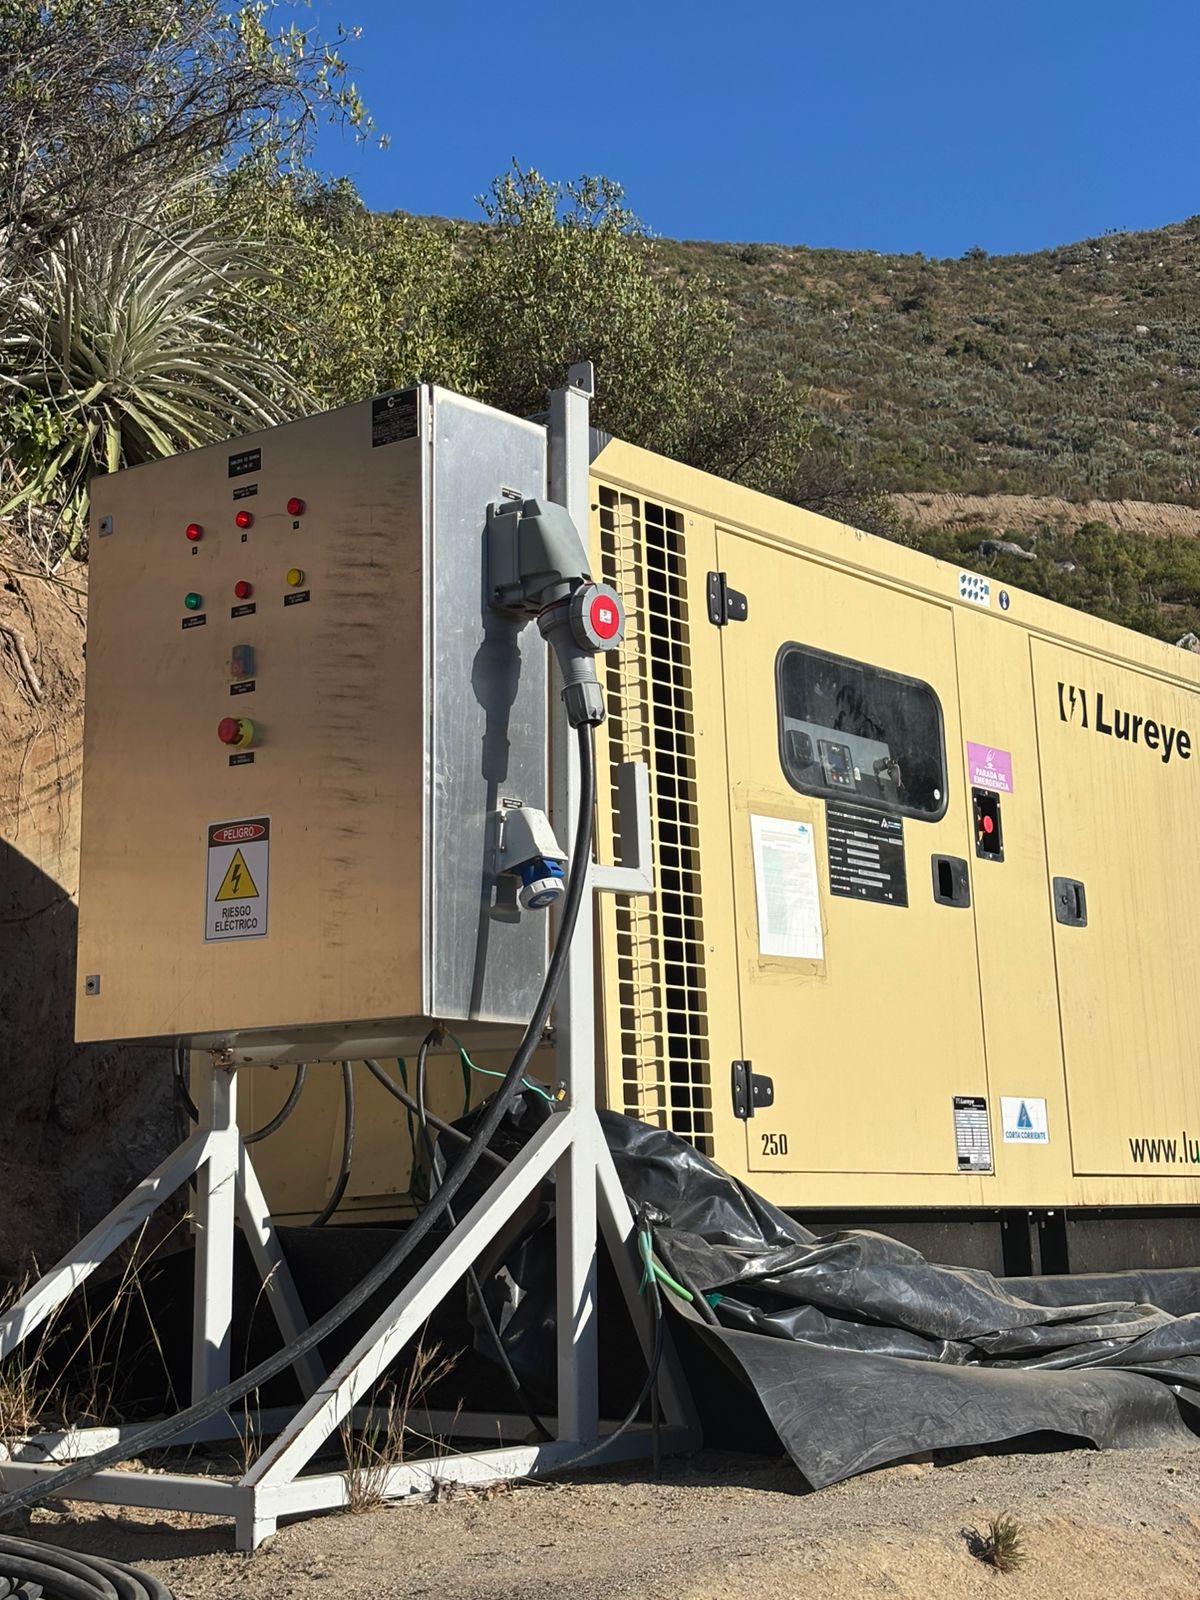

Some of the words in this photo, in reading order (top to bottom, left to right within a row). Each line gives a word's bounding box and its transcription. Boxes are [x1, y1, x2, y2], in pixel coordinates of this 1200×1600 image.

[1096, 692, 1192, 764] Lureye
[975, 767, 998, 780] PARADA
[998, 772, 1006, 782] DE
[973, 775, 1010, 791] EMERGENCIA
[223, 826, 254, 840] PELIGRO
[222, 905, 251, 918] RIESGO
[1005, 1131, 1021, 1139] CORTA
[1021, 1131, 1046, 1140] CORRIENTE
[761, 1133, 788, 1156] 250
